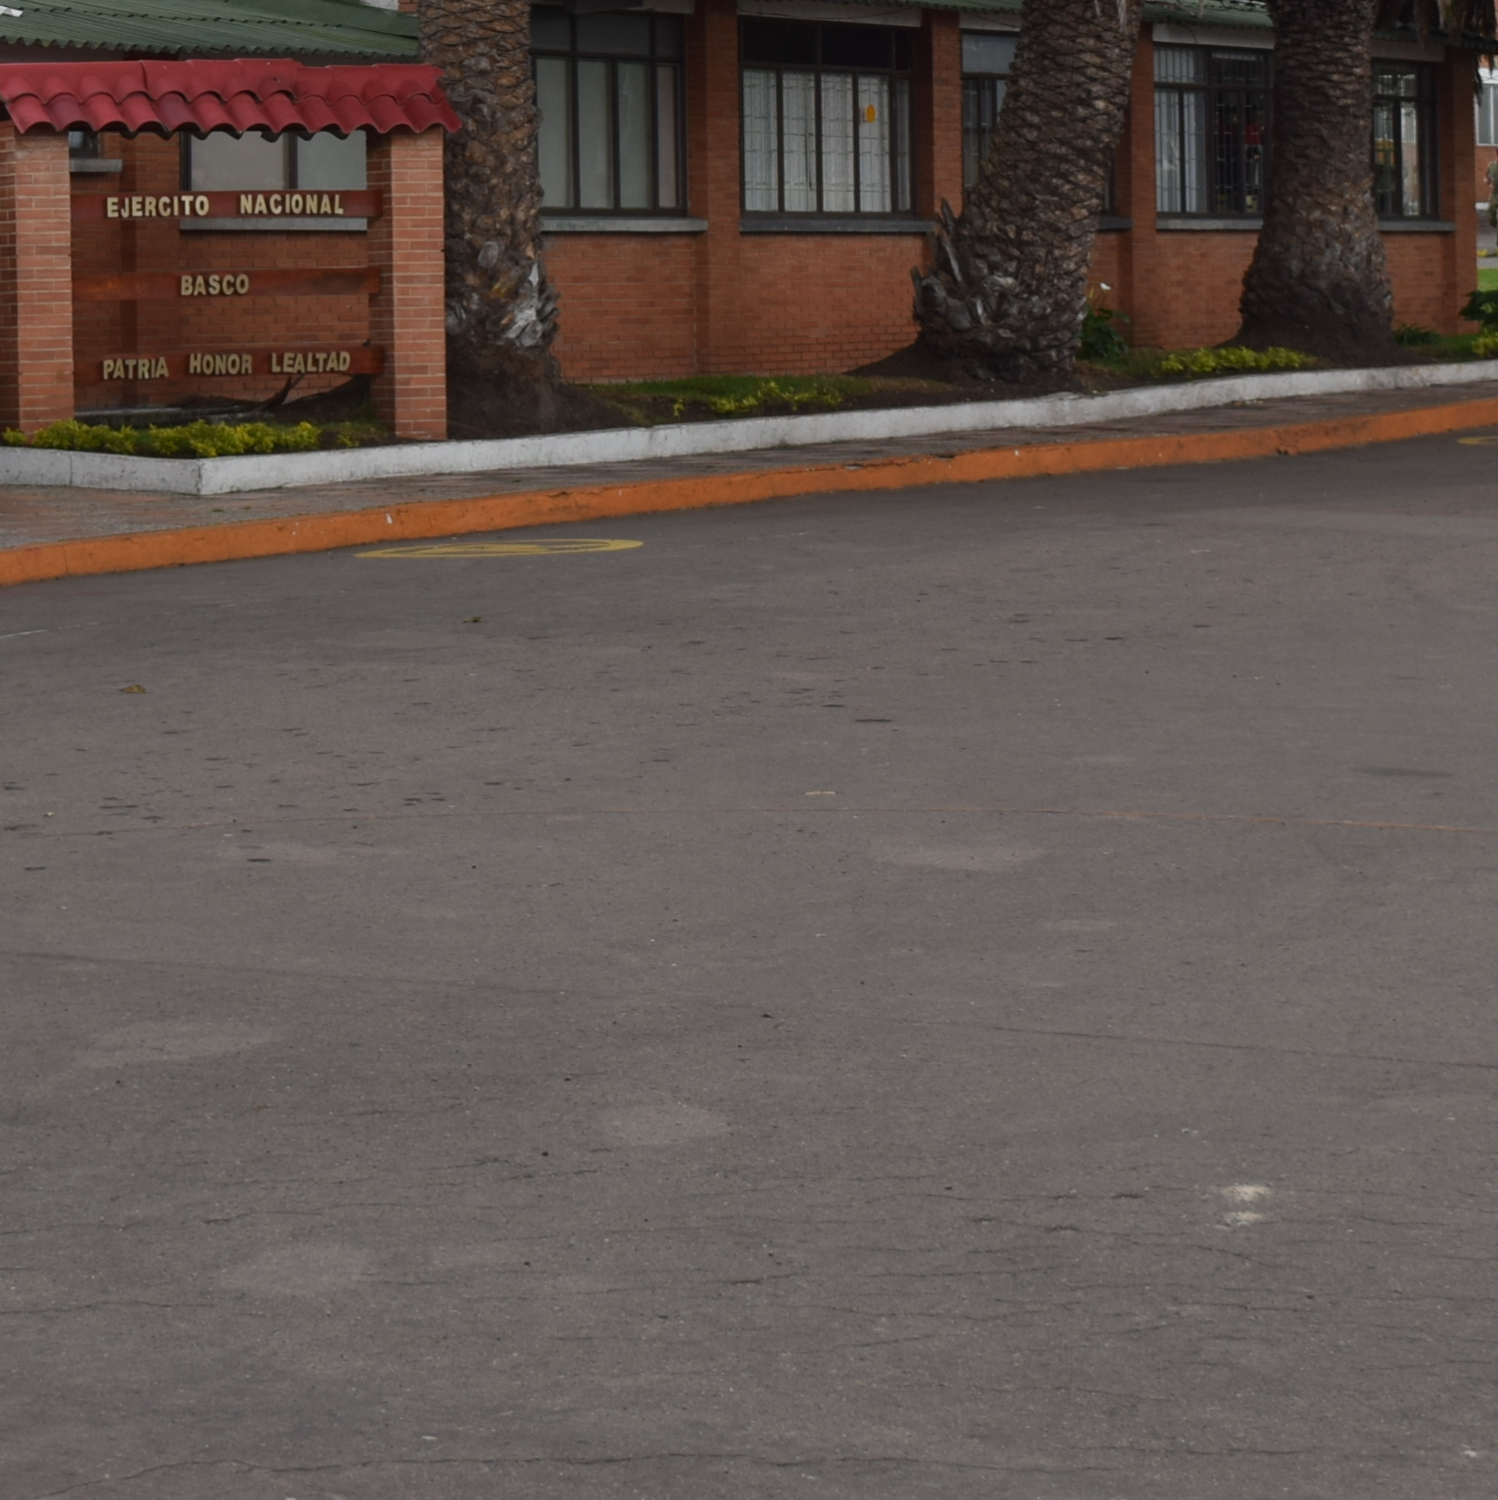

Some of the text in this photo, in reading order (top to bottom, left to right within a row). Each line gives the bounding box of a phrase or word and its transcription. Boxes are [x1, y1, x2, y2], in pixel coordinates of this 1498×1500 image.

[106, 193, 345, 218] EJERCITO NACIONAL
[179, 273, 251, 297] BASCO
[102, 351, 352, 380] PATRIA HONOR LEALTAD
